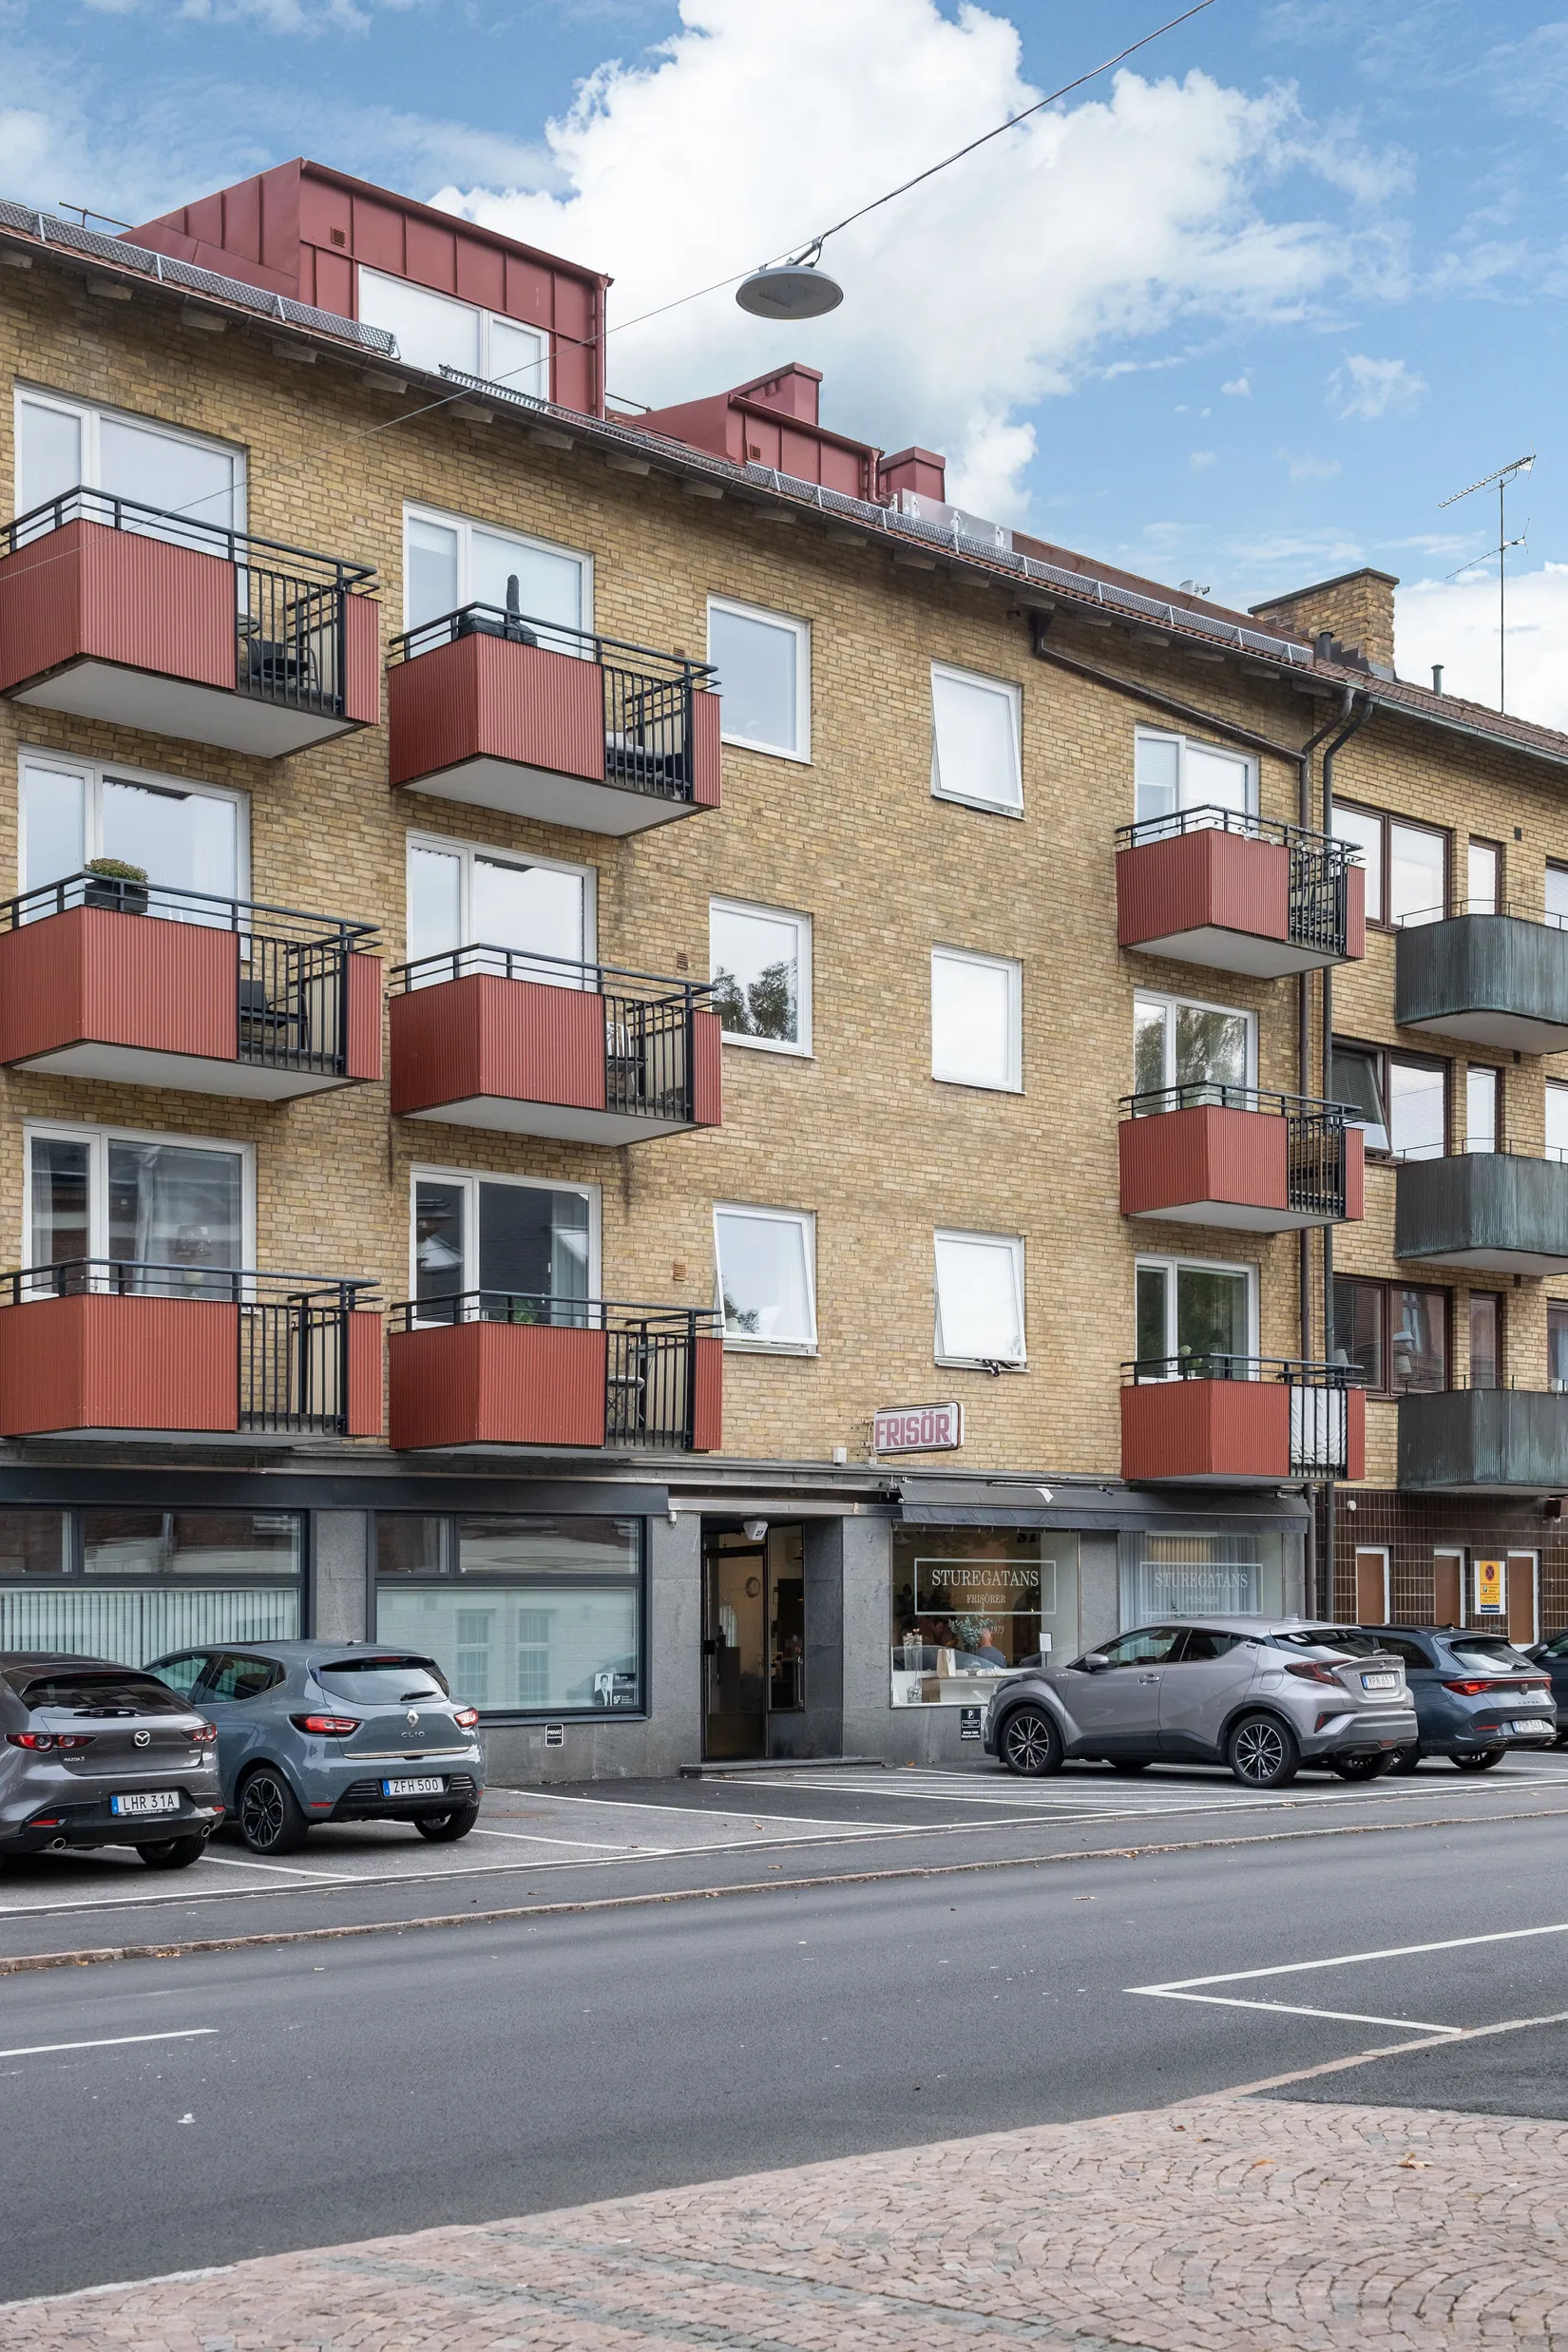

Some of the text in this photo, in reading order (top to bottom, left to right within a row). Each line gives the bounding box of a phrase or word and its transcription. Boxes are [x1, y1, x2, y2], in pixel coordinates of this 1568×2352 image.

[874, 1410, 950, 1447] FRISÖR
[931, 1569, 1039, 1586] STUREGATANS
[1155, 1572, 1249, 1589] STUREGATANS
[966, 1593, 1006, 1604] FRISÖRER
[990, 1625, 1005, 1634] 1975
[1368, 1675, 1380, 1685] XPN
[393, 1779, 438, 1792] ZFH 500
[123, 1793, 175, 1810] LHR 31A
